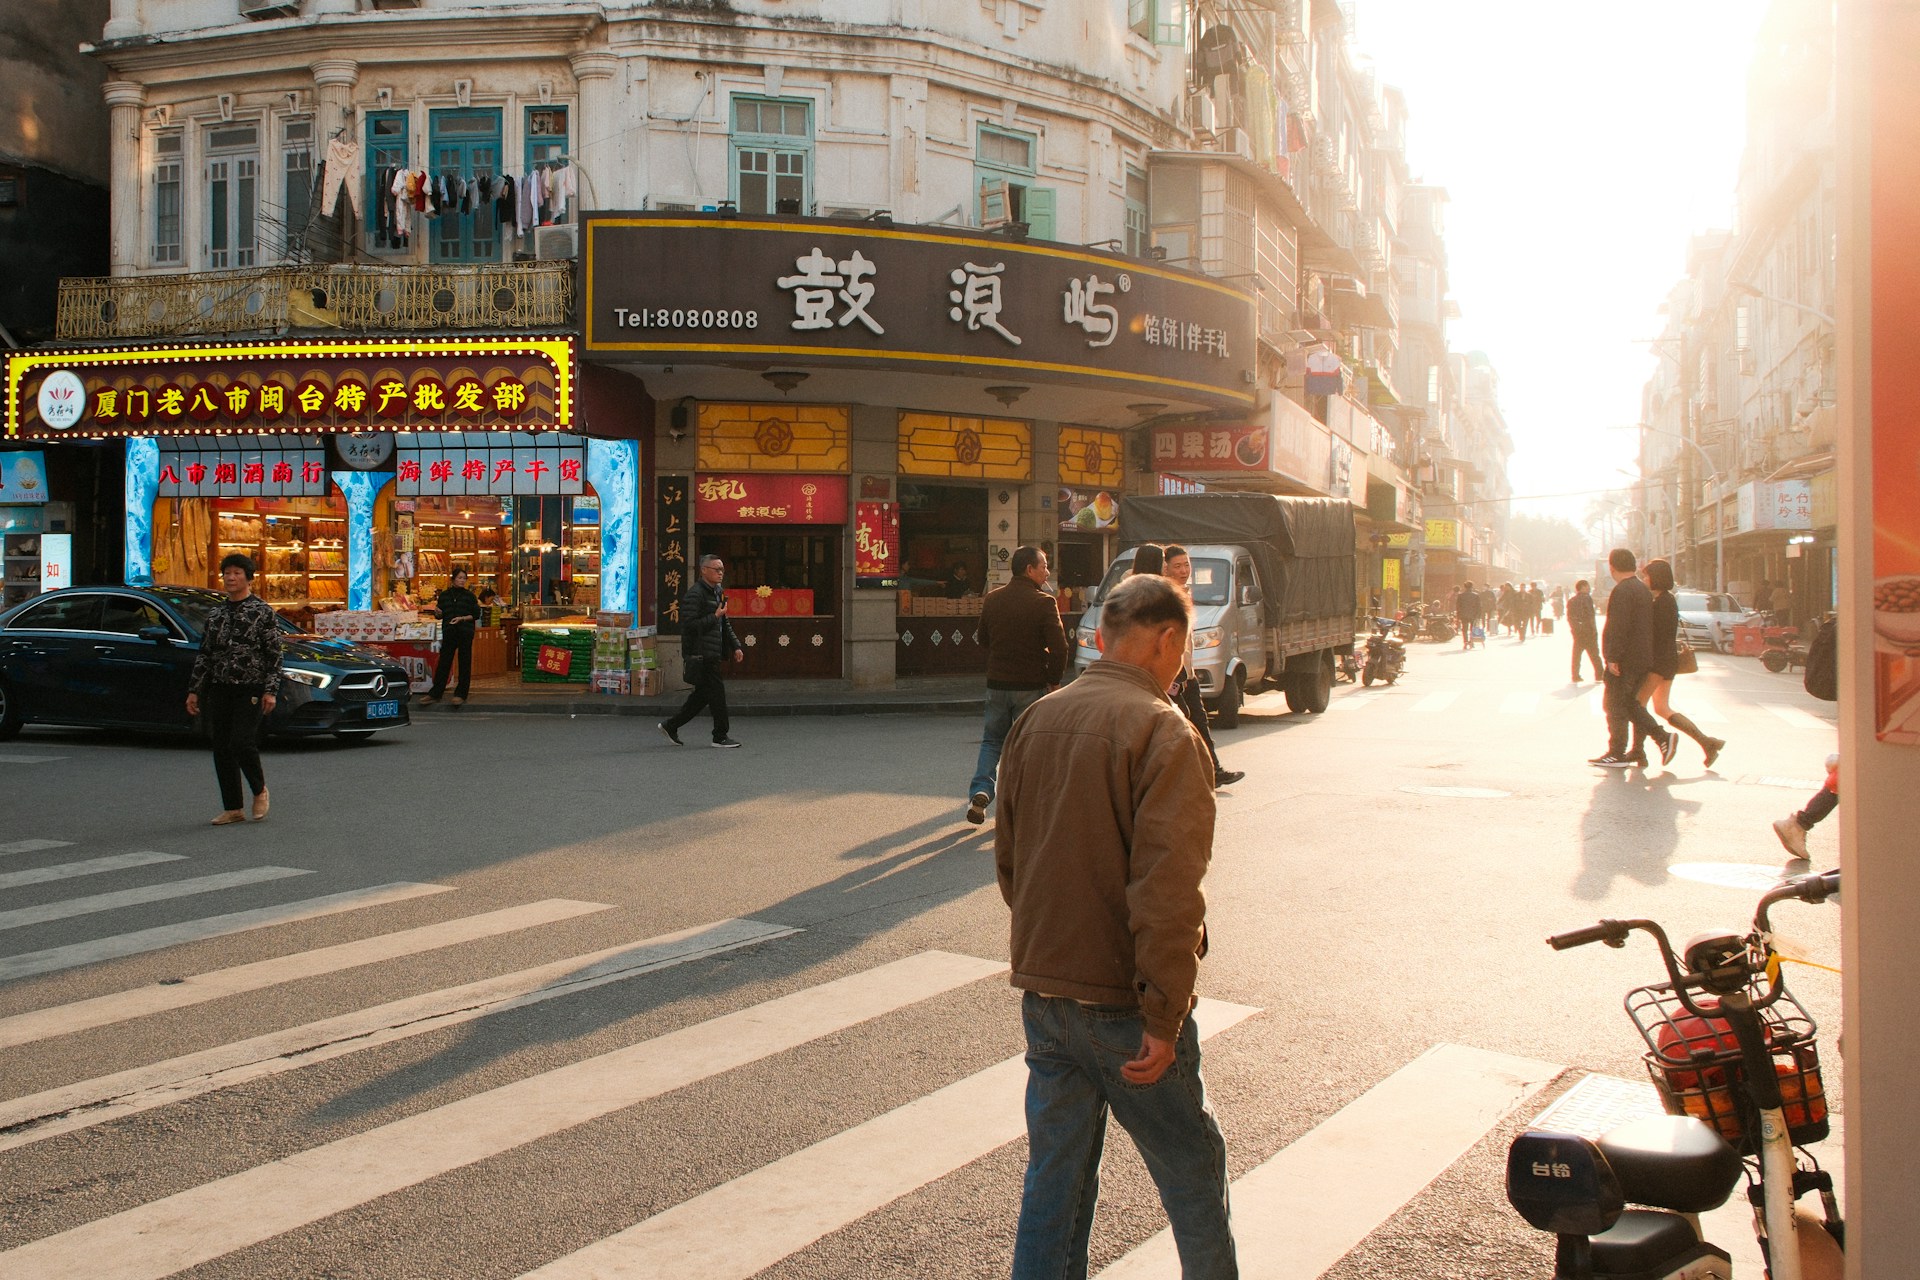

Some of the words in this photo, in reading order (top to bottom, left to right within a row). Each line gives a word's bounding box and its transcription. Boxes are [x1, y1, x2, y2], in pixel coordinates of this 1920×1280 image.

[614, 308, 758, 328] Tel:8080808
[94, 381, 528, 418] 厦门老八市闽台特产批发部
[1155, 431, 1232, 459] 四果汤
[159, 461, 325, 485] 八市烟酒商行
[398, 459, 581, 483] 海鲜特产干货
[698, 477, 747, 501] 有礼
[737, 506, 787, 518] 鼓浪屿
[856, 522, 889, 560] 有礼
[545, 648, 566, 661] 海苔
[547, 659, 560, 671] 8元
